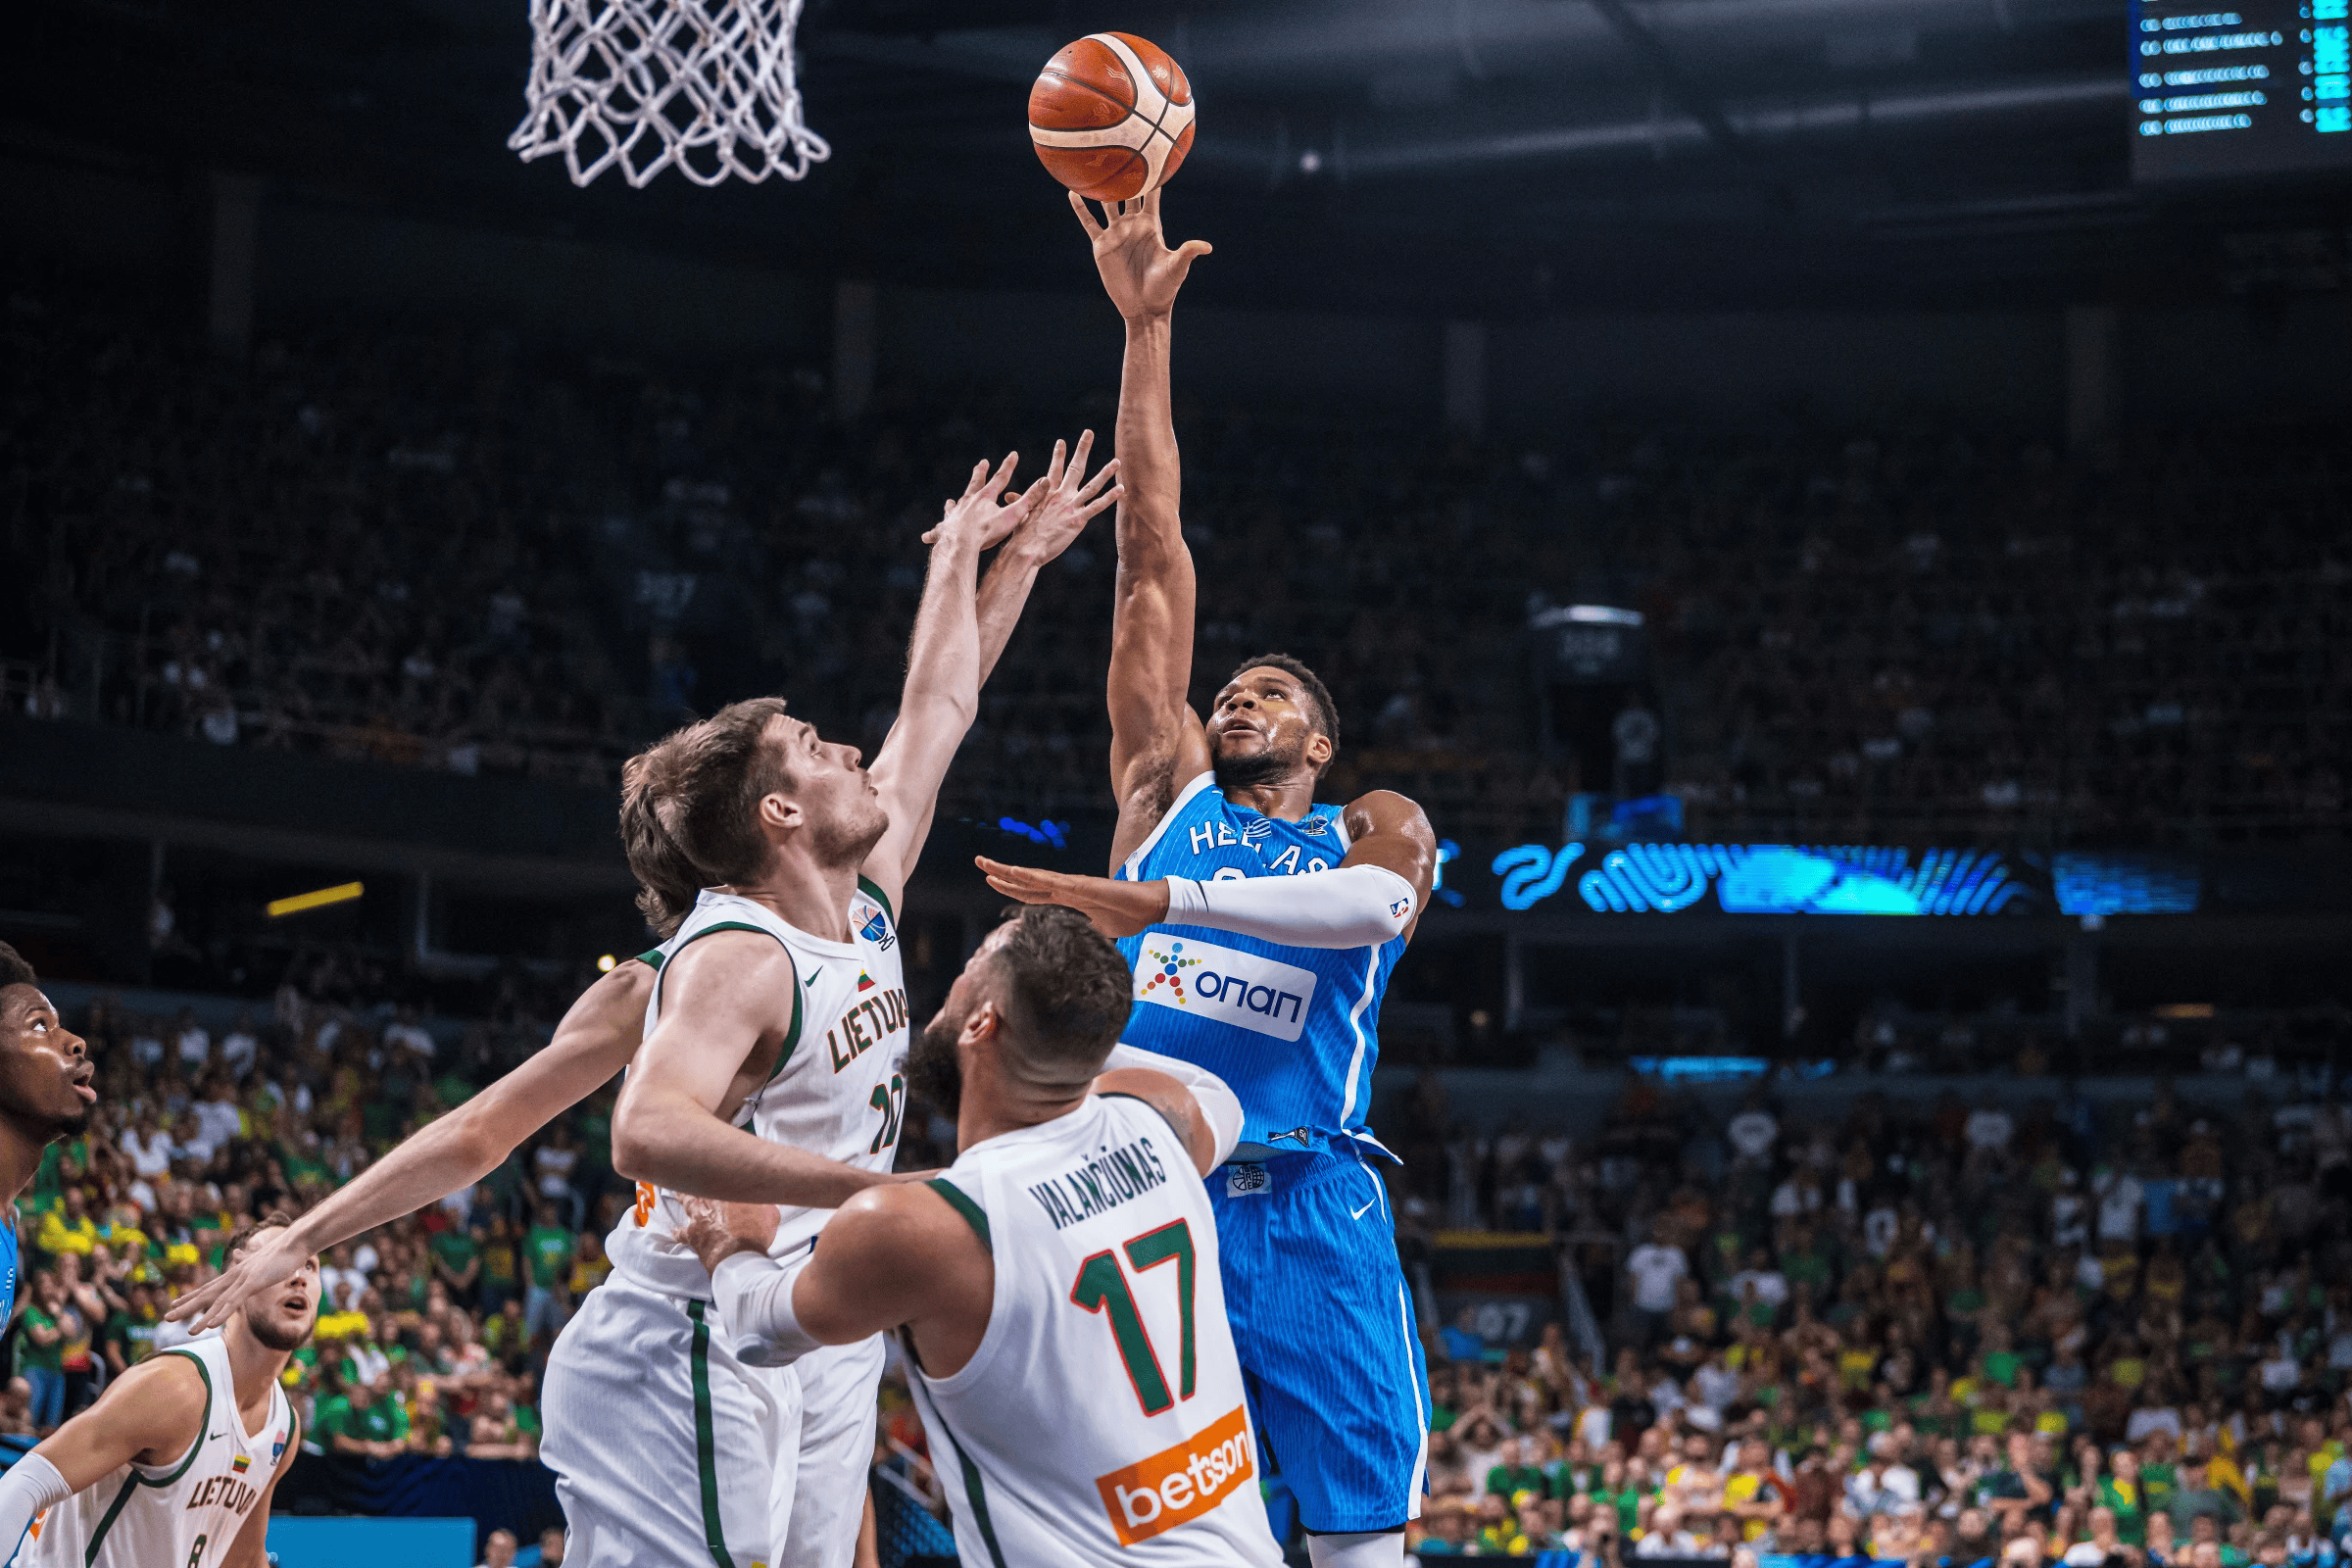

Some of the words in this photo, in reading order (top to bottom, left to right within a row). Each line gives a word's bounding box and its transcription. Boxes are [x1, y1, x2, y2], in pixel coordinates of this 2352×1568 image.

[1189, 820, 1329, 875] HELAS
[868, 1073, 903, 1154] 20
[1028, 1137, 1166, 1231] VALANČIŪNAS
[1069, 1217, 1197, 1417] 17
[186, 1476, 257, 1516] LIETUV
[1114, 1430, 1251, 1529] betson
